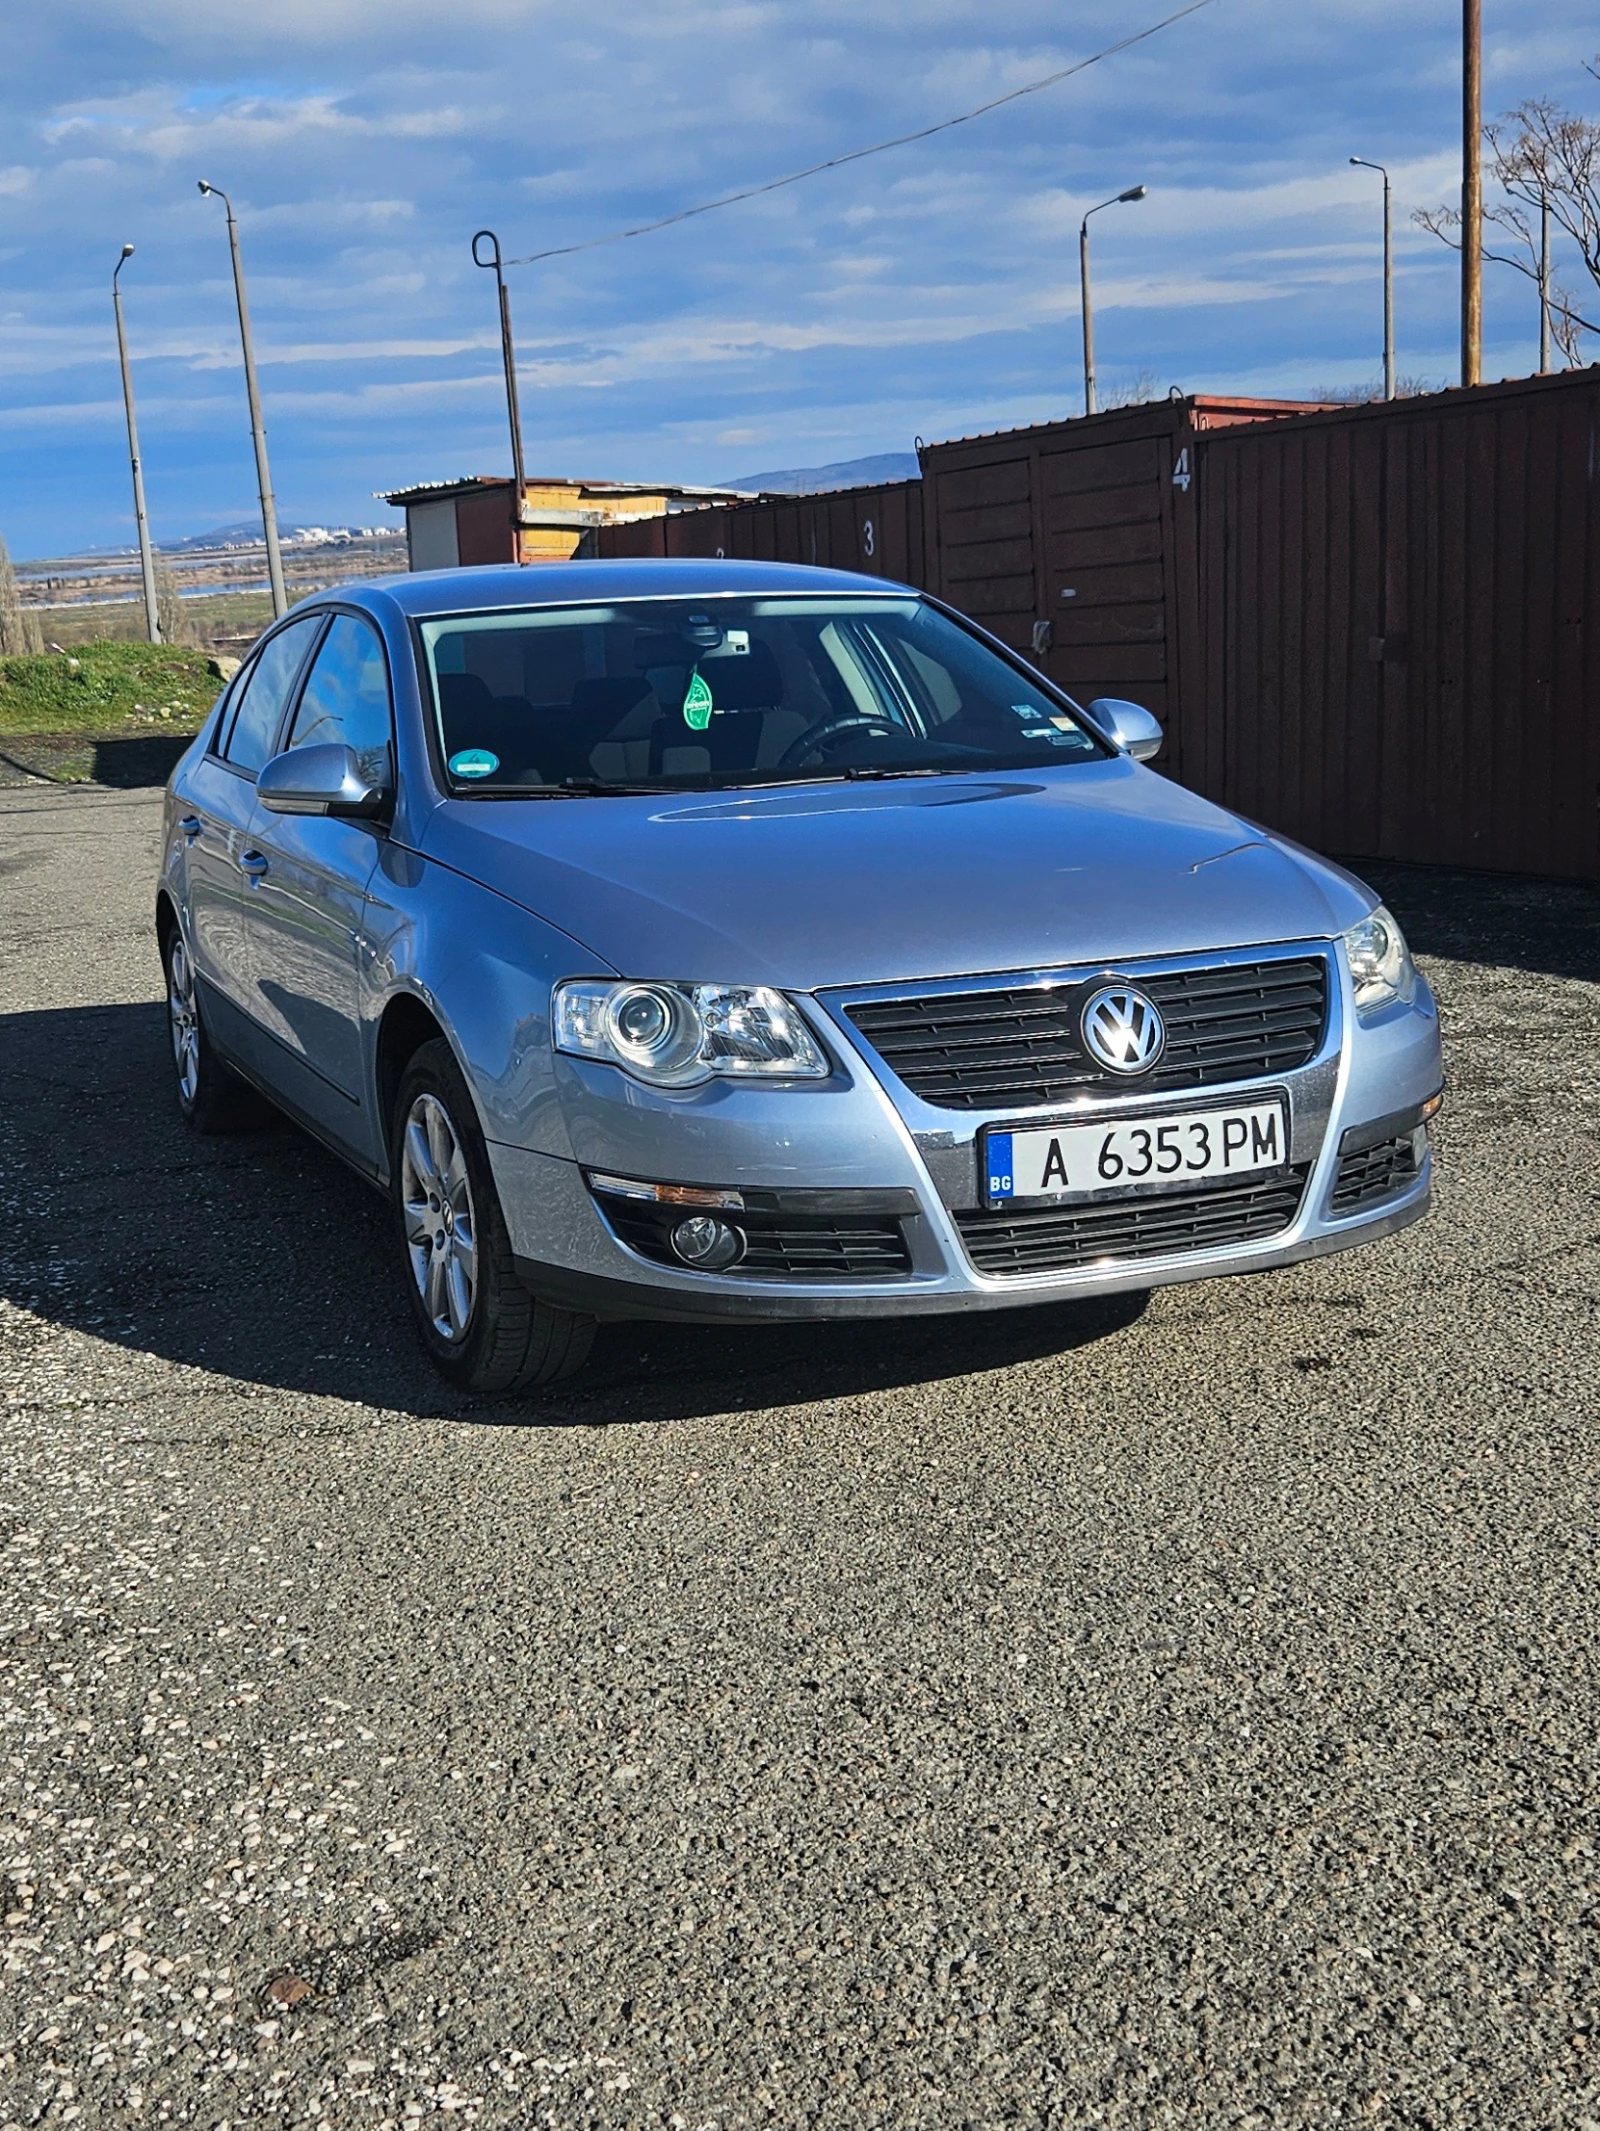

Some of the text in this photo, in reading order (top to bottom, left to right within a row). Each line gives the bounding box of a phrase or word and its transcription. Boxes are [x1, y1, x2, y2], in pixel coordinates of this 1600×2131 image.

[1172, 447, 1191, 492] 4
[863, 519, 874, 556] 3
[468, 753, 480, 764] 4
[1086, 989, 1161, 1072] VW
[1041, 1113, 1278, 1188] A 6353 PM
[989, 1174, 1012, 1192] BG
